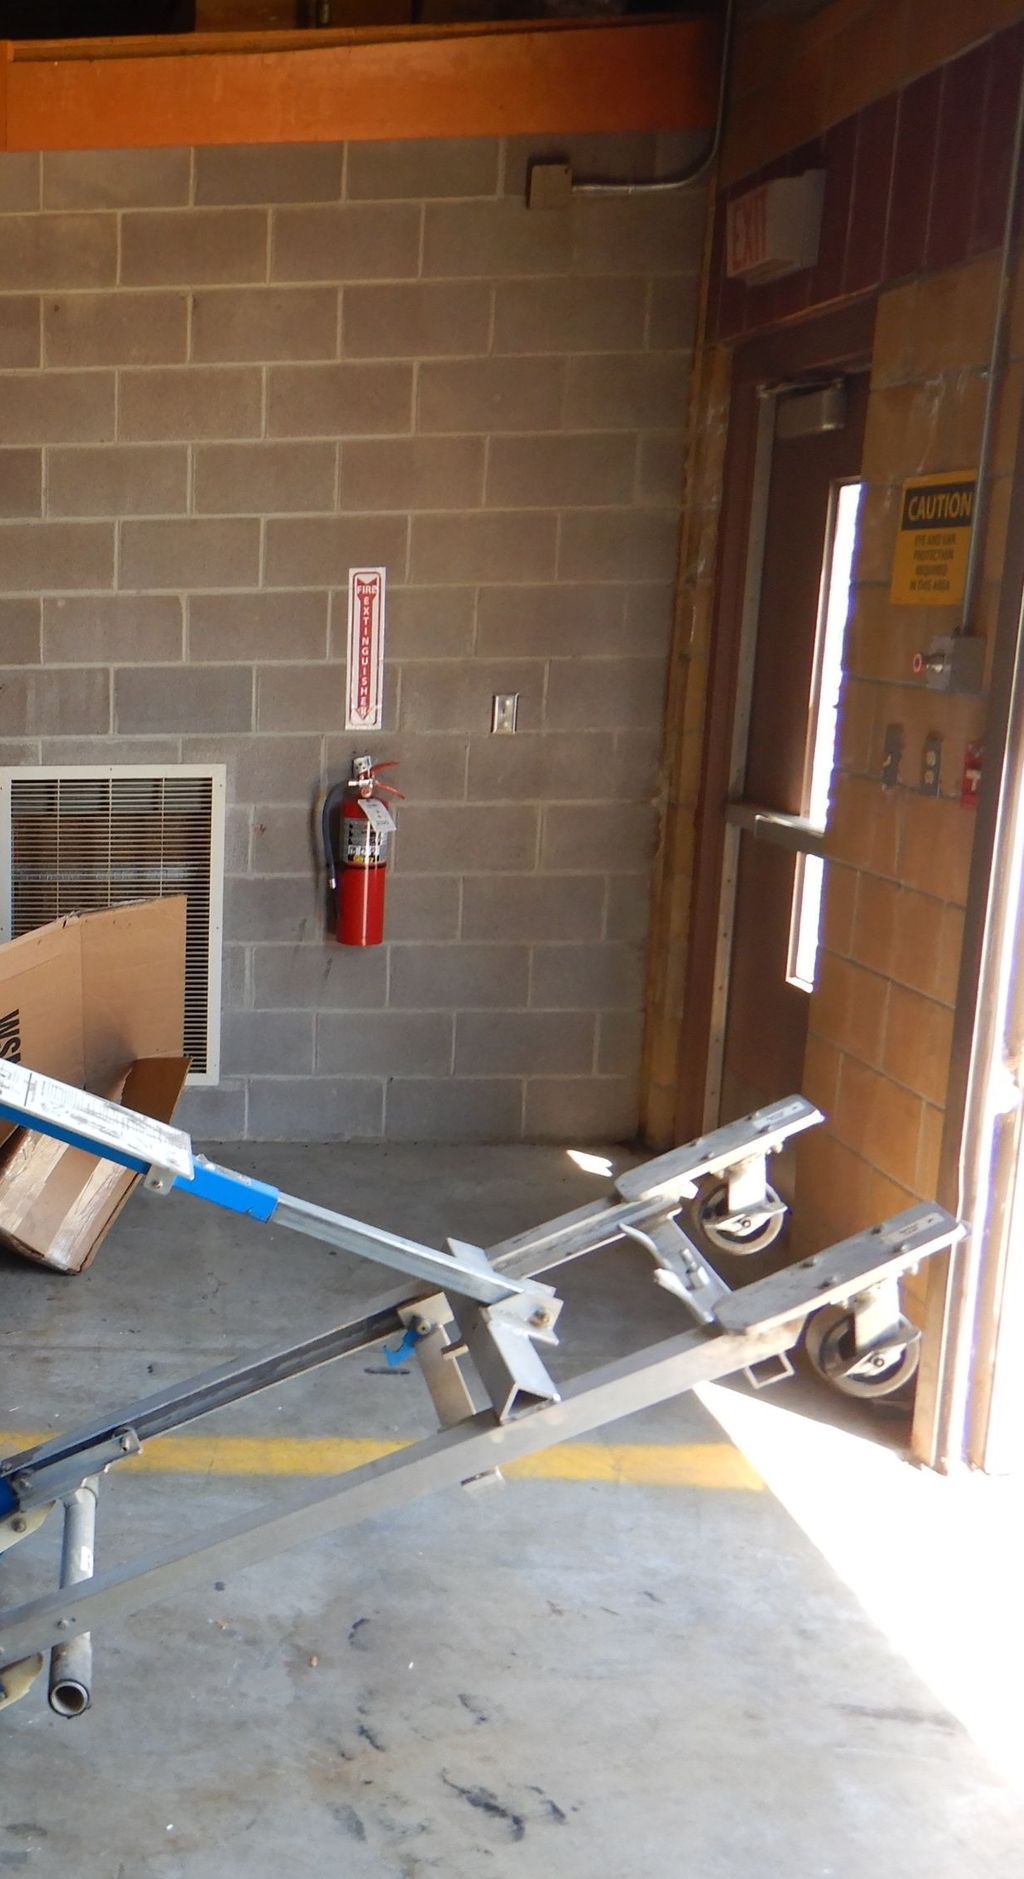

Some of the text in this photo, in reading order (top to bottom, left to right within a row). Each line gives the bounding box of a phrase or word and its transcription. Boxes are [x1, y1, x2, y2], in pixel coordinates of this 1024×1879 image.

[908, 492, 973, 521] CAUTION
[357, 584, 377, 594] FIRE
[360, 596, 371, 716] EXTINGUISHER
